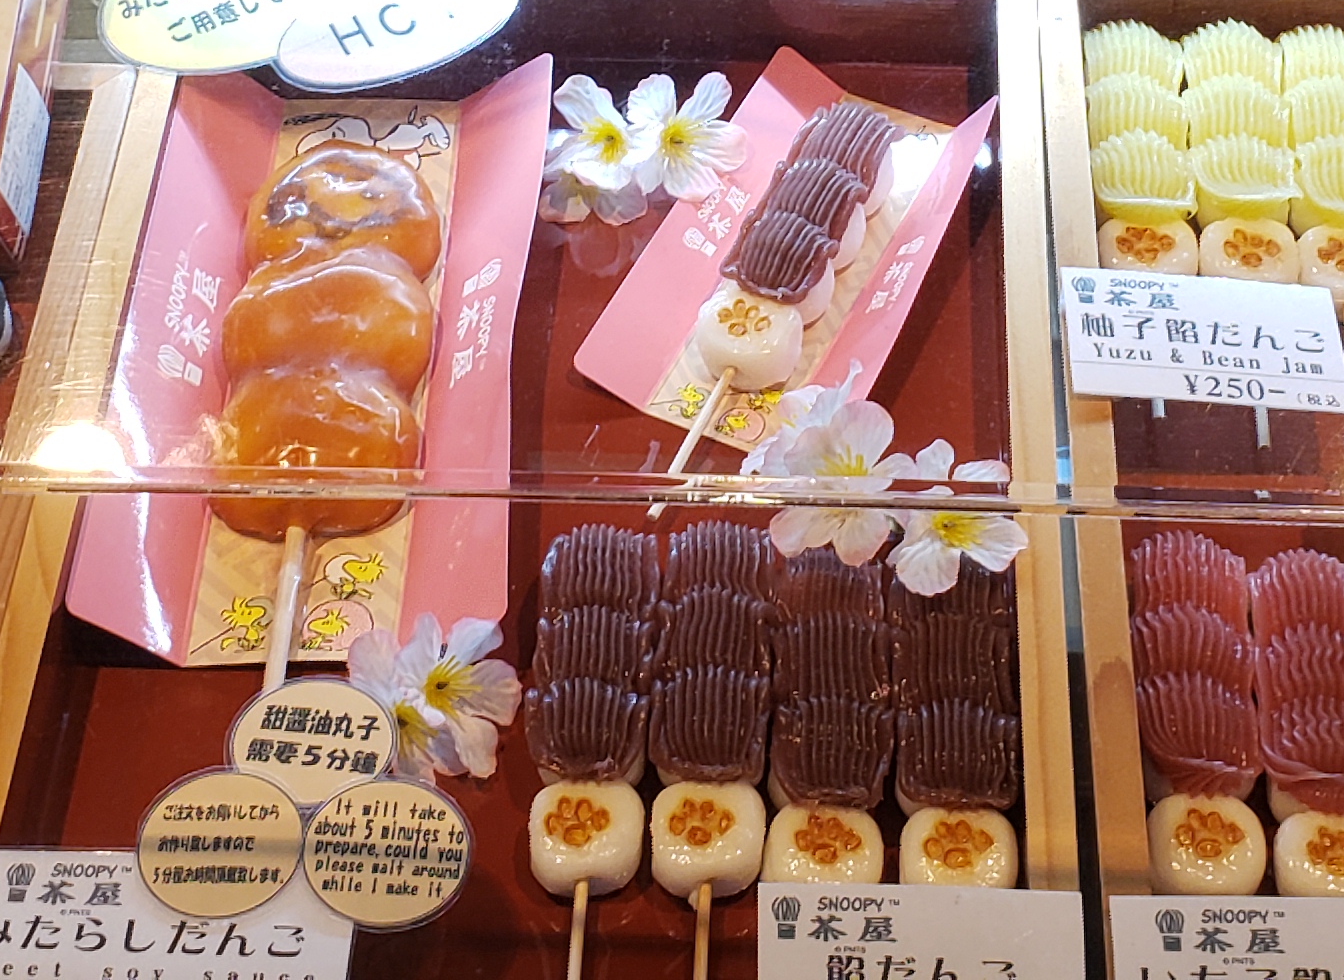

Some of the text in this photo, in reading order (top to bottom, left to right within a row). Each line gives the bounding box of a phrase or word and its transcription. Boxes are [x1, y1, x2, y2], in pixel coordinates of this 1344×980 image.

[165, 262, 190, 329] SNOOPY
[1109, 278, 1165, 290] SNOOPY
[179, 268, 222, 357] 茶屋
[1105, 290, 1180, 310] 茶屋
[476, 295, 496, 358] SNOOPY
[1081, 312, 1325, 354] 柚子餡だんご
[450, 299, 481, 389] 茶屋
[1093, 342, 1152, 361] Yuzu
[1170, 348, 1185, 364] &
[1202, 350, 1261, 370] Bean
[1184, 374, 1287, 401] ¥250-
[336, 798, 446, 821] It will take
[314, 816, 464, 845] about 5 minutes to
[314, 839, 463, 863] prepare, could you
[51, 863, 118, 878] SNOOPY
[315, 856, 460, 880] please wait around
[36, 880, 122, 905] 茶屋
[322, 875, 362, 892] while
[386, 880, 418, 896] make
[817, 896, 884, 912] SNOOPY
[1201, 908, 1269, 924] SNOOPY
[807, 914, 898, 941] 茶屋
[1194, 926, 1286, 953] 茶屋
